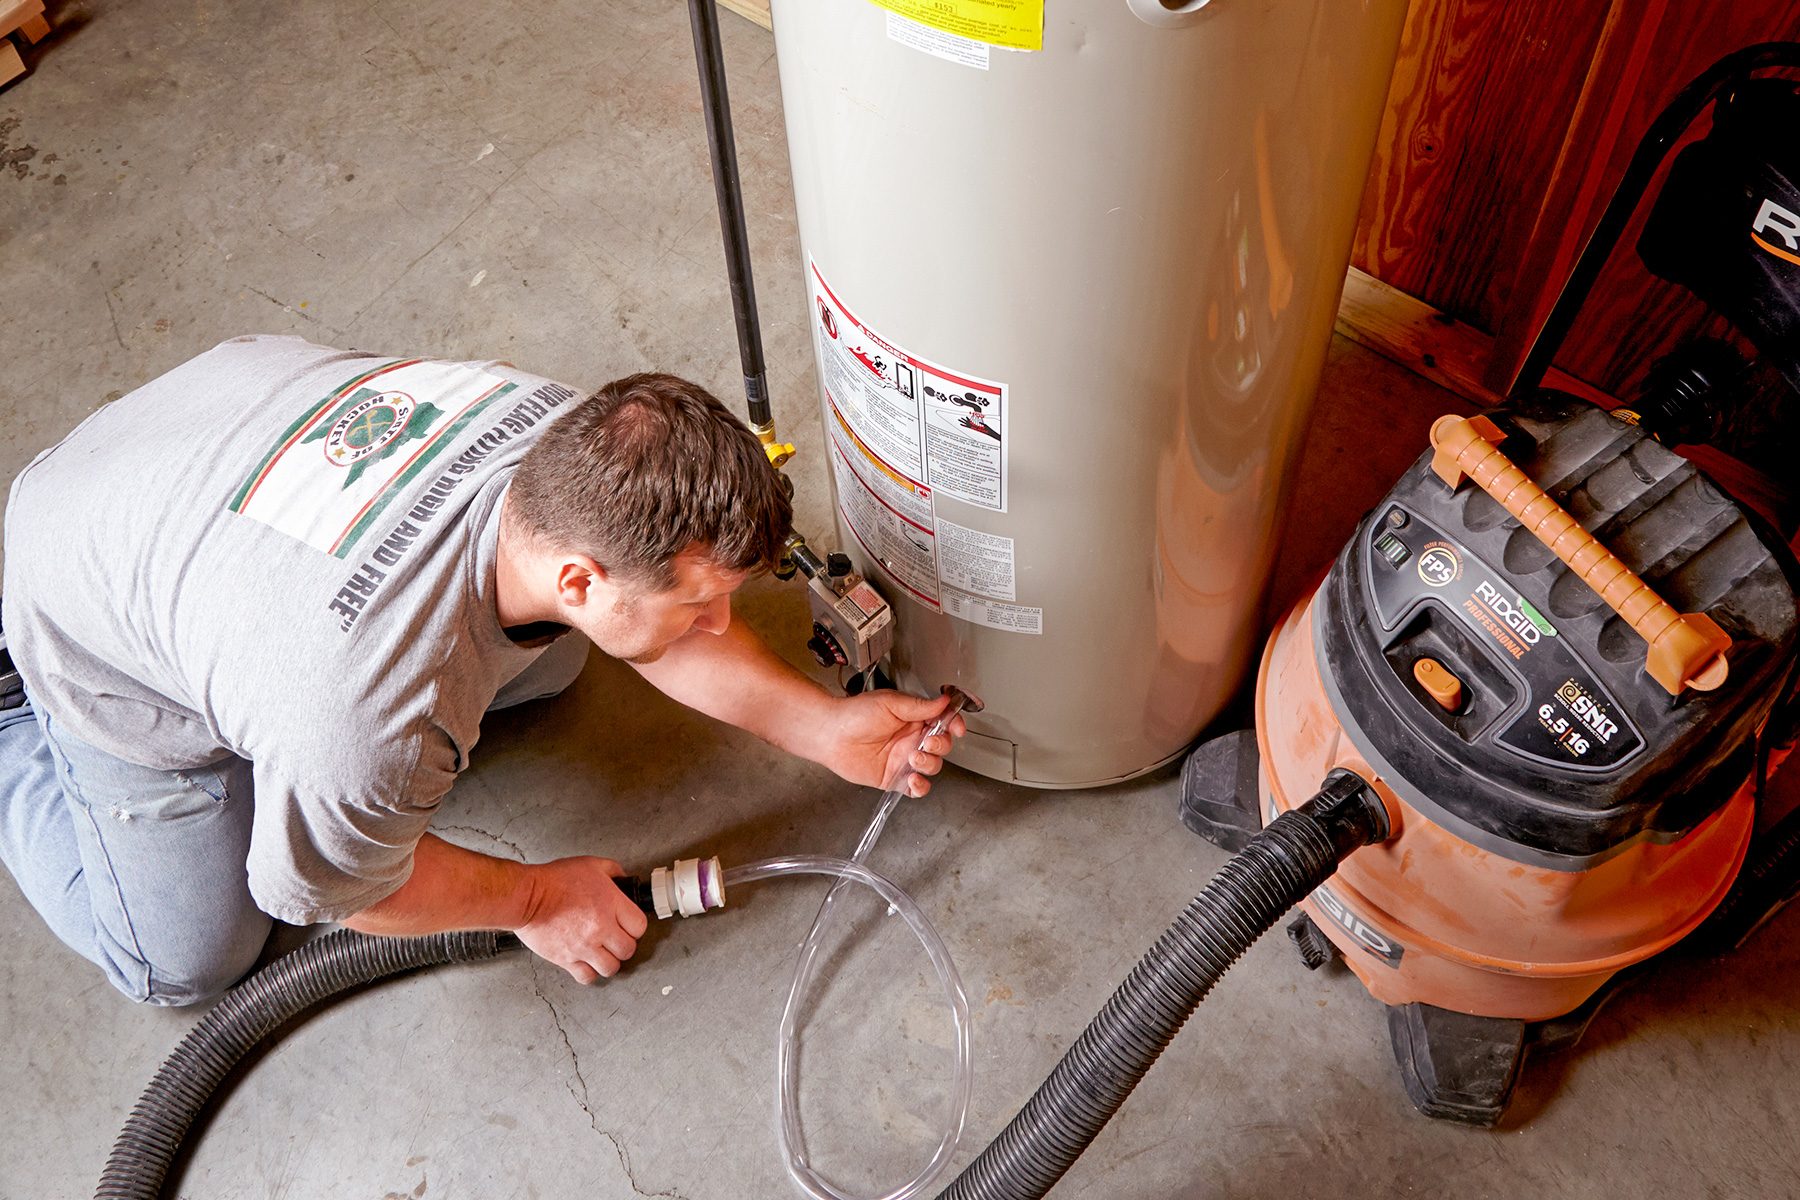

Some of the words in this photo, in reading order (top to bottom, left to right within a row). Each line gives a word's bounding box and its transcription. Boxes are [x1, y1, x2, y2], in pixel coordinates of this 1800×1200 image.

[866, 331, 909, 362] DANGER
[330, 396, 384, 446] HOCKEY
[499, 398, 549, 435] FLAG
[408, 475, 463, 522] HIGH
[372, 520, 422, 567] AND
[1420, 554, 1451, 581] FPS
[1463, 600, 1524, 660] PROFESSIONAL
[1475, 580, 1540, 644] RIDGID
[1554, 693, 1570, 710] SCROLL
[1582, 721, 1606, 744] REDUCTION
[1570, 677, 1606, 713] PATENTED
[1571, 695, 1618, 741] SNR
[1539, 704, 1569, 733] 6.5
[1568, 732, 1590, 754] 16
[1316, 888, 1392, 953] GID
